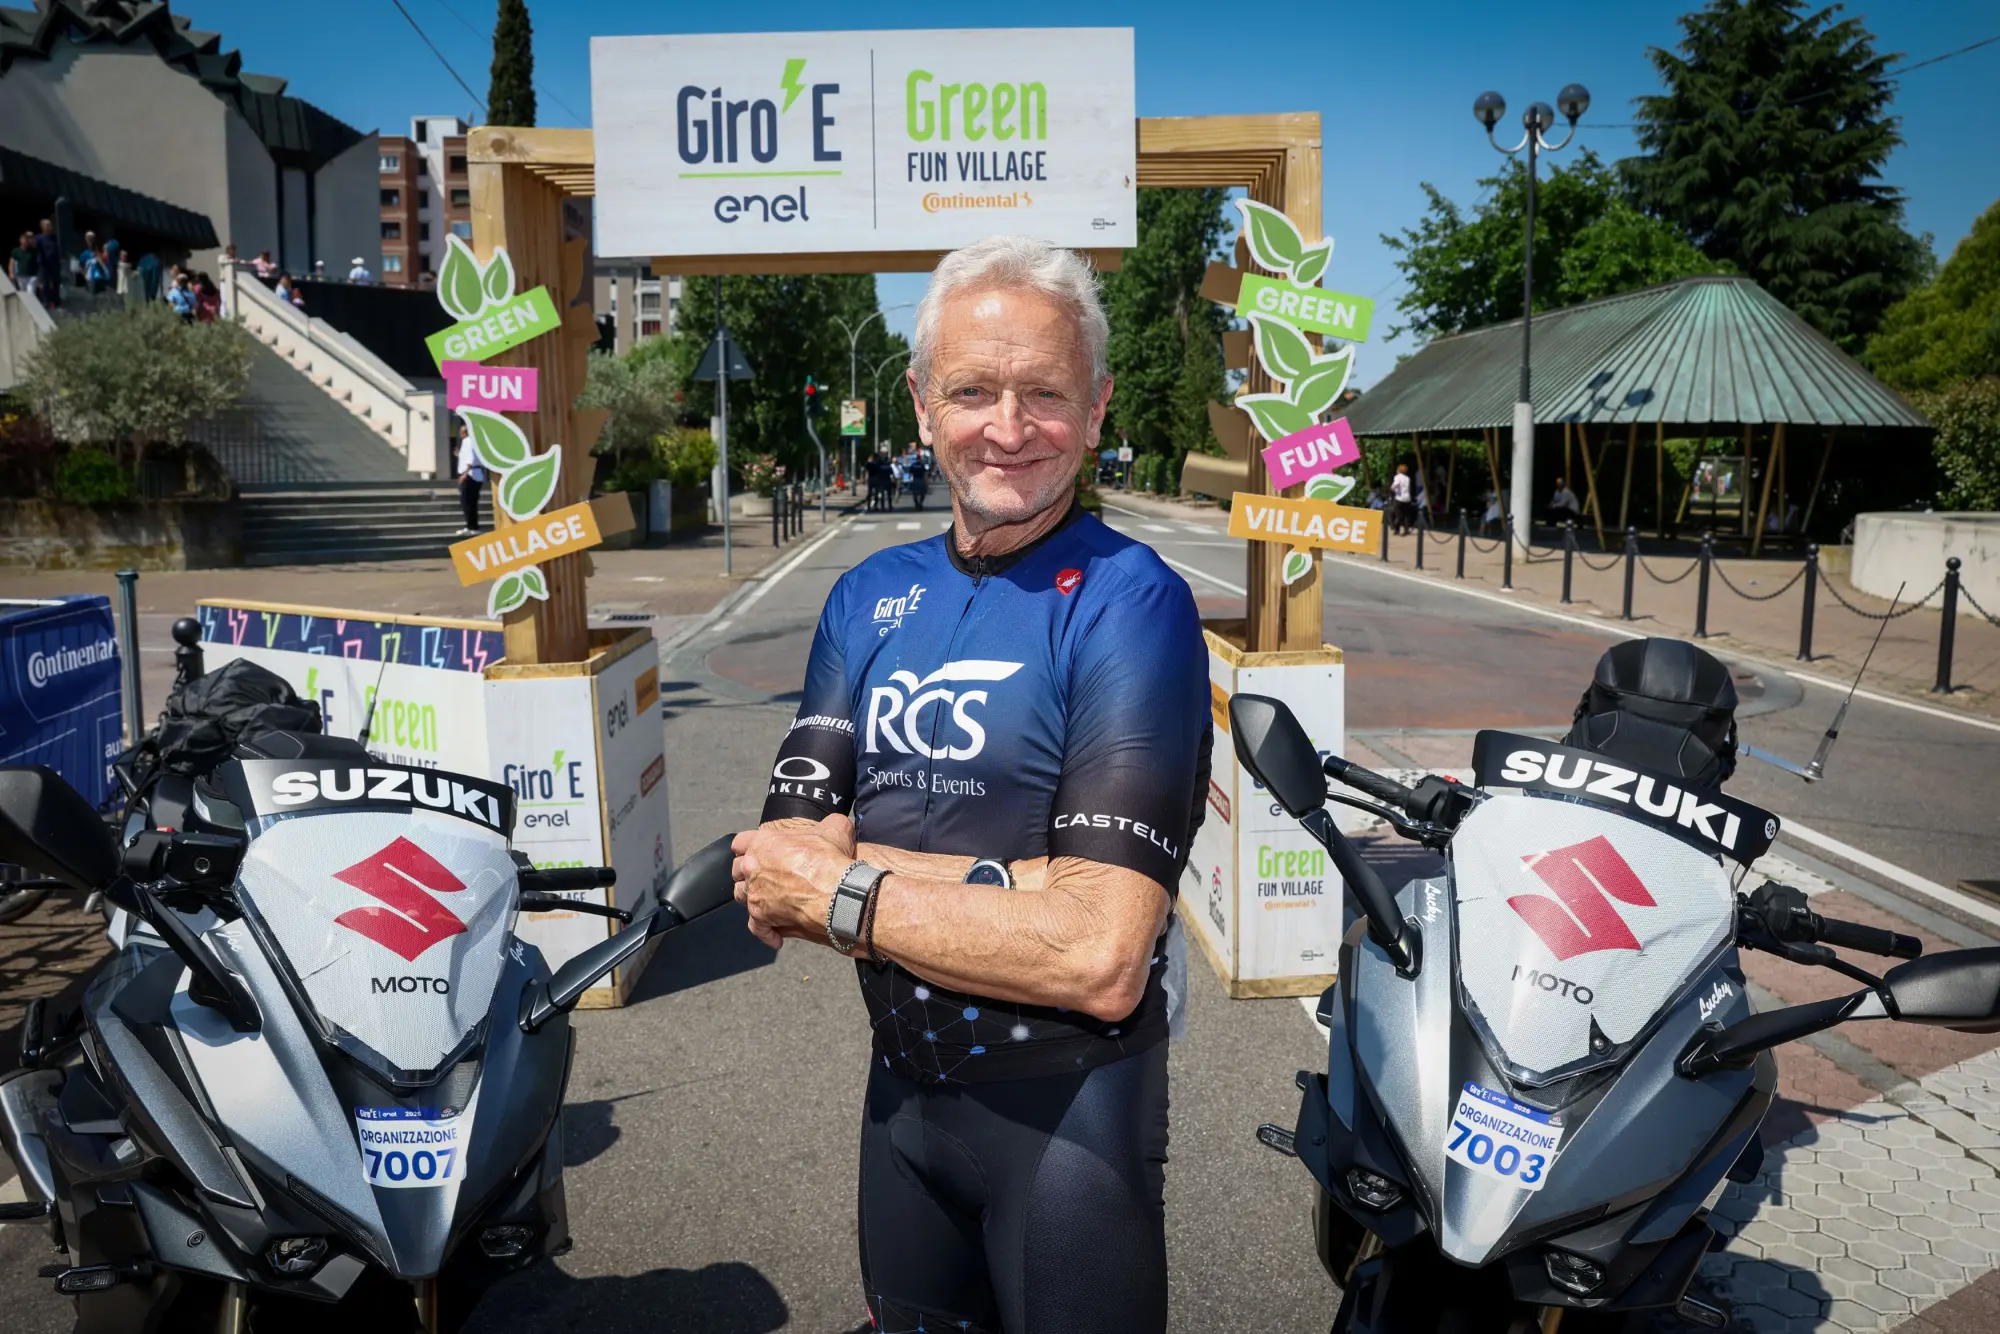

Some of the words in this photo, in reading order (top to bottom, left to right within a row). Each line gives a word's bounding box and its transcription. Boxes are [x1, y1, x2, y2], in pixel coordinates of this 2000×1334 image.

[905, 69, 1047, 142] Green
[907, 152, 947, 182] FUN
[957, 151, 1047, 181] VILLAGE
[714, 186, 809, 223] enel
[922, 192, 1018, 213] Continental
[1256, 287, 1357, 330] GREEN
[444, 301, 540, 360] GREEN
[461, 375, 523, 400] FUN
[1279, 432, 1343, 476] FUN
[465, 514, 586, 572] VILLAGE
[1244, 505, 1368, 545] VILLAGE
[365, 685, 438, 752] Green
[607, 688, 630, 738] enel
[865, 685, 989, 762] RCS
[271, 767, 501, 829] SUZUKI
[767, 782, 843, 806] AKLEY
[867, 766, 912, 791] Sports
[916, 772, 927, 789] &
[932, 773, 986, 797] Events
[1501, 748, 1742, 850] SUZUKI
[523, 809, 570, 828] enel
[1054, 813, 1179, 860] CASTELLI
[1257, 845, 1325, 879] Green
[1257, 882, 1277, 897] FUN
[1281, 880, 1324, 896] VILLAGE
[1424, 881, 1443, 924] Lucky
[370, 975, 450, 995] MOTO
[1511, 963, 1594, 1005] MOTO
[1699, 981, 1734, 1021] Lucky
[360, 1127, 458, 1144] ORGANIZZAZIONE
[1459, 1102, 1556, 1150] ORGANIZZAZIONE
[364, 1146, 458, 1181] 7007
[1447, 1119, 1546, 1184] 7003
